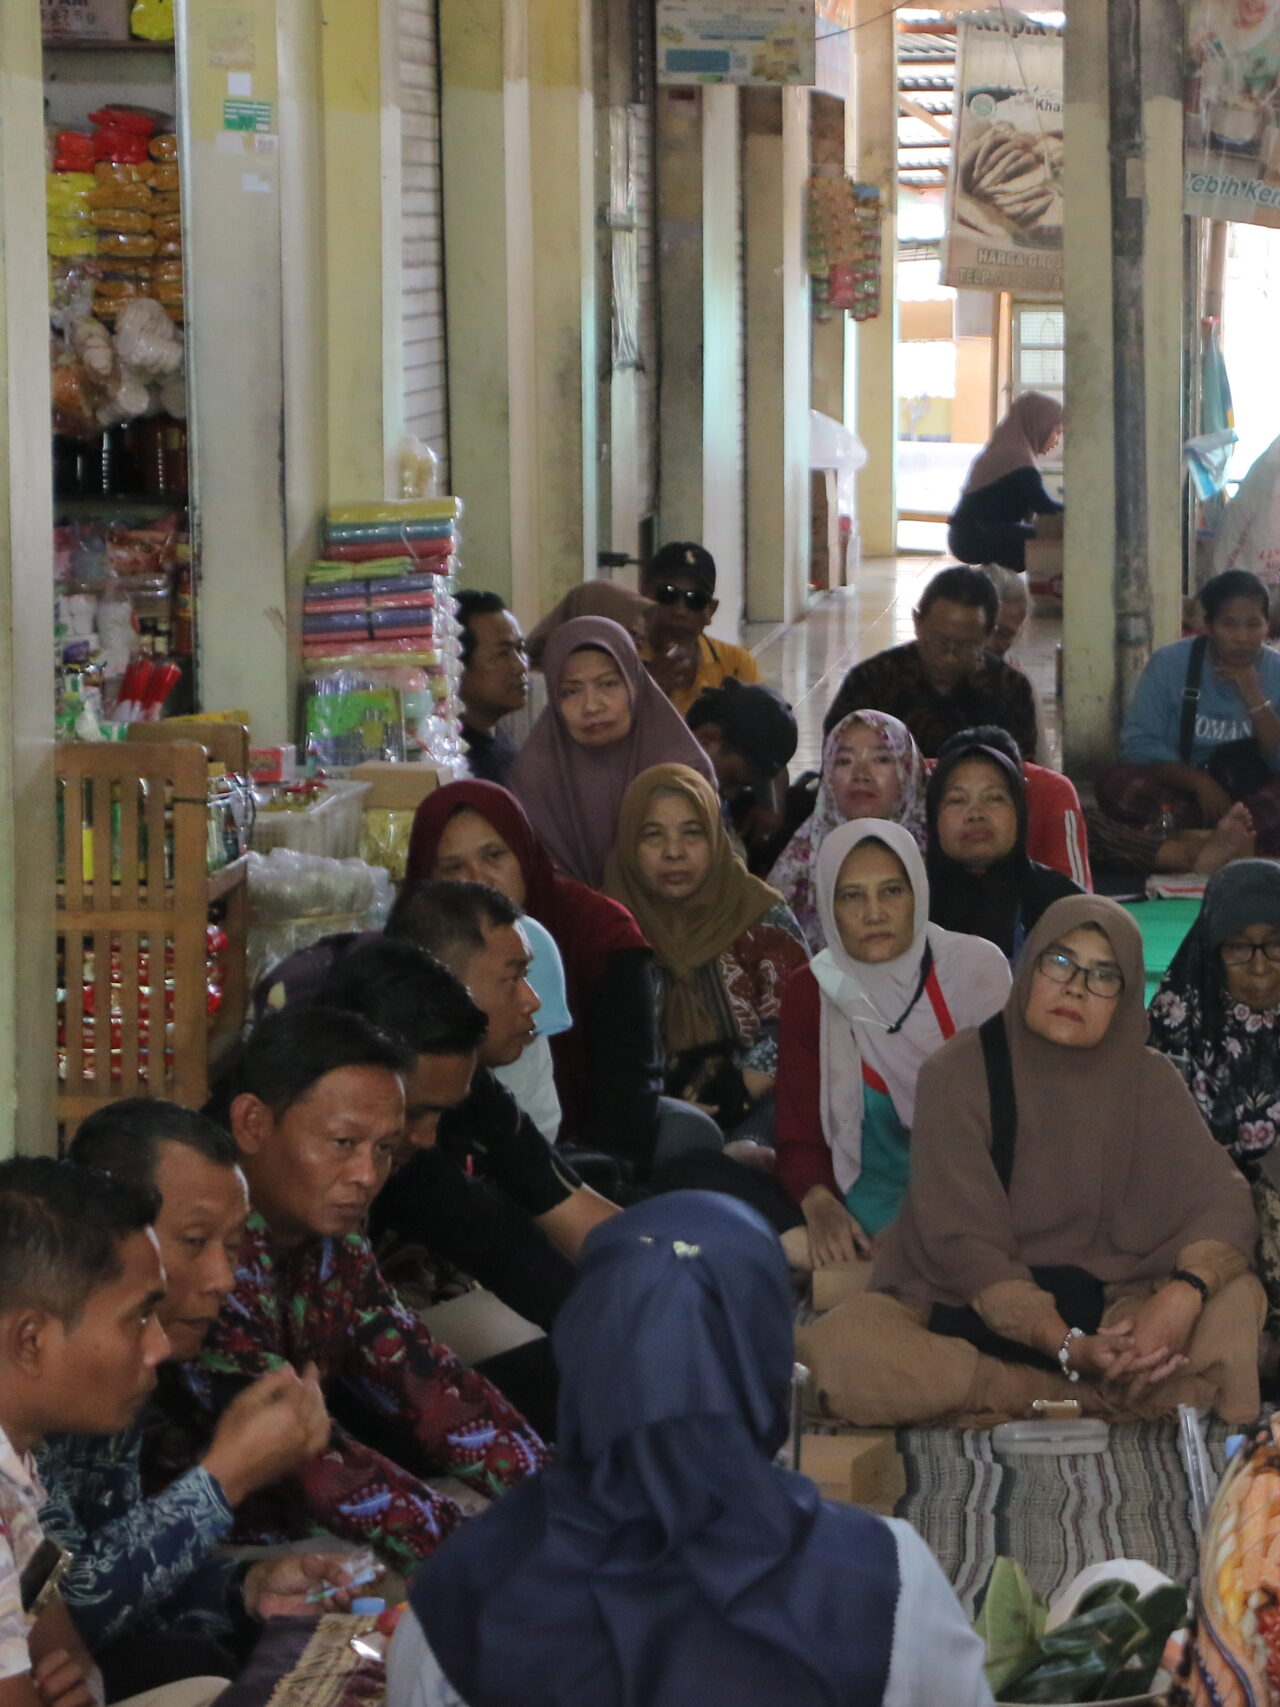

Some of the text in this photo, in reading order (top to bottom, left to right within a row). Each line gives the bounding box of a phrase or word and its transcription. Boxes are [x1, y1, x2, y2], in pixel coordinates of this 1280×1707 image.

[1036, 99, 1063, 112] Kha
[978, 248, 1025, 266] HARGA
[1195, 713, 1253, 740] OMAN
